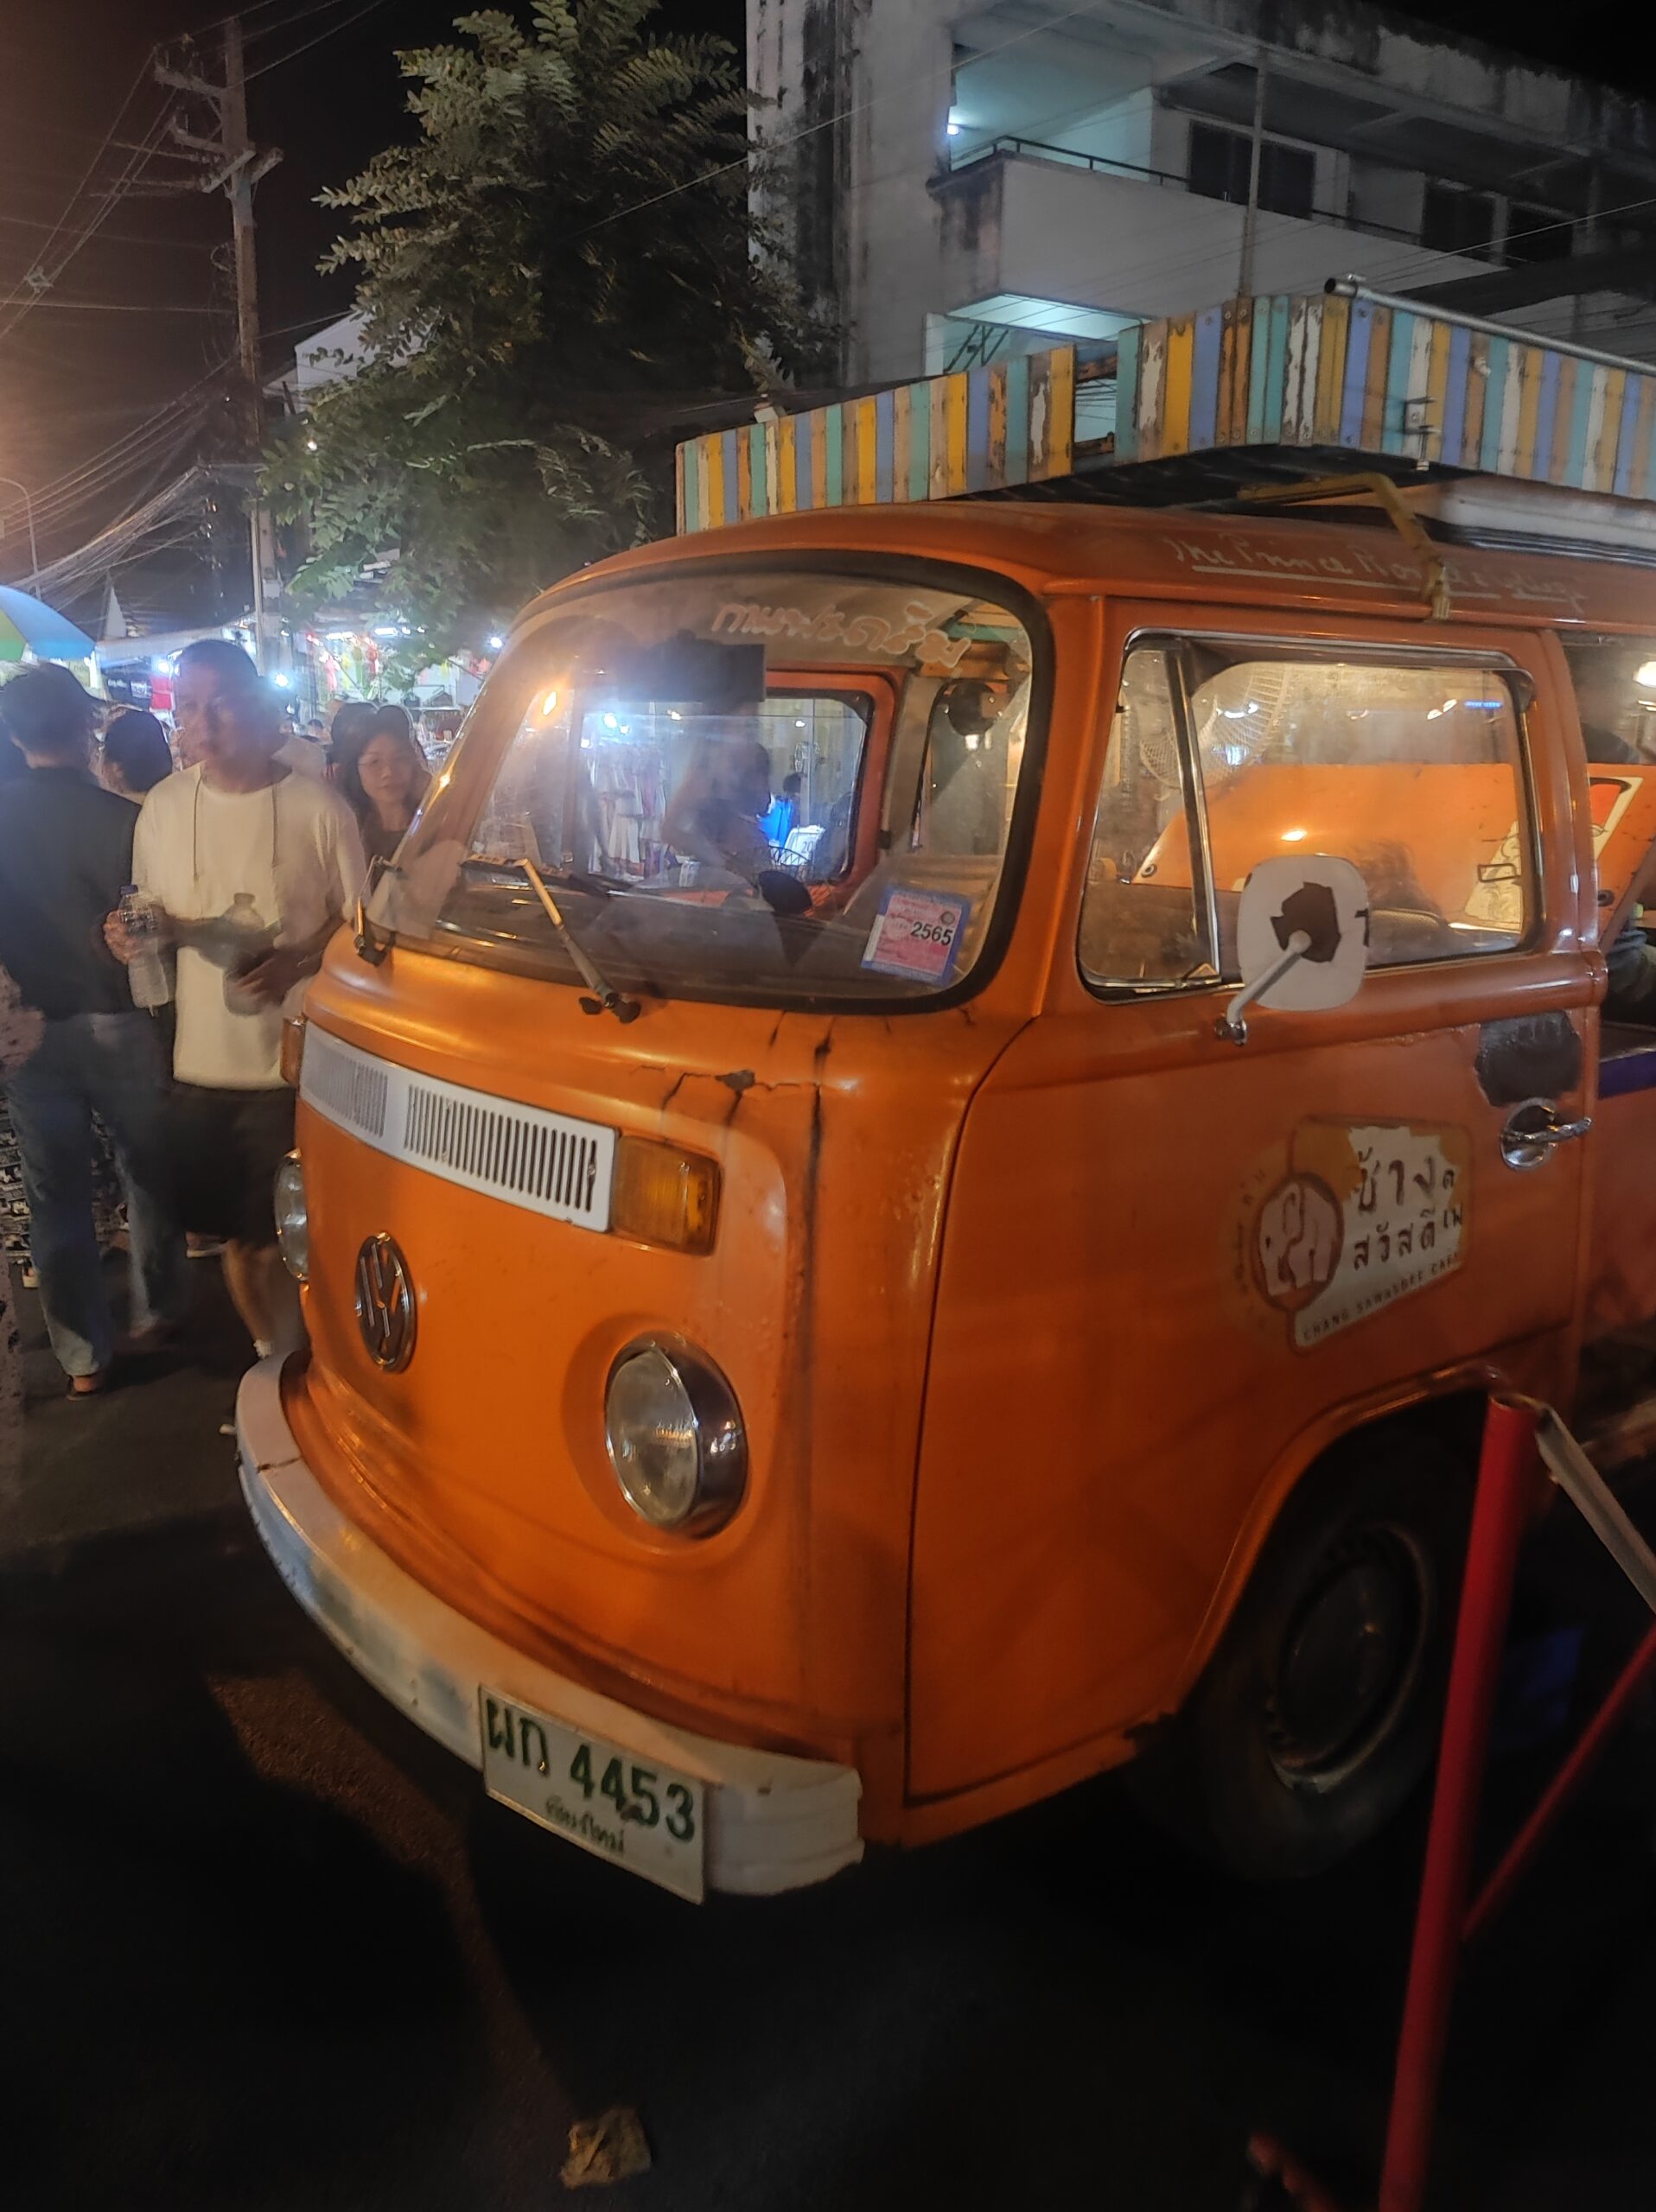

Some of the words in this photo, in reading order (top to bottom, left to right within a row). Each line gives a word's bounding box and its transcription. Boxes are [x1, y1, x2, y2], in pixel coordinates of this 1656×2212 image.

[910, 921, 952, 946] 2565
[1353, 1208, 1436, 1271] สวัสดี
[1303, 1308, 1349, 1340] CHANG
[570, 1745, 695, 1843] 4453
